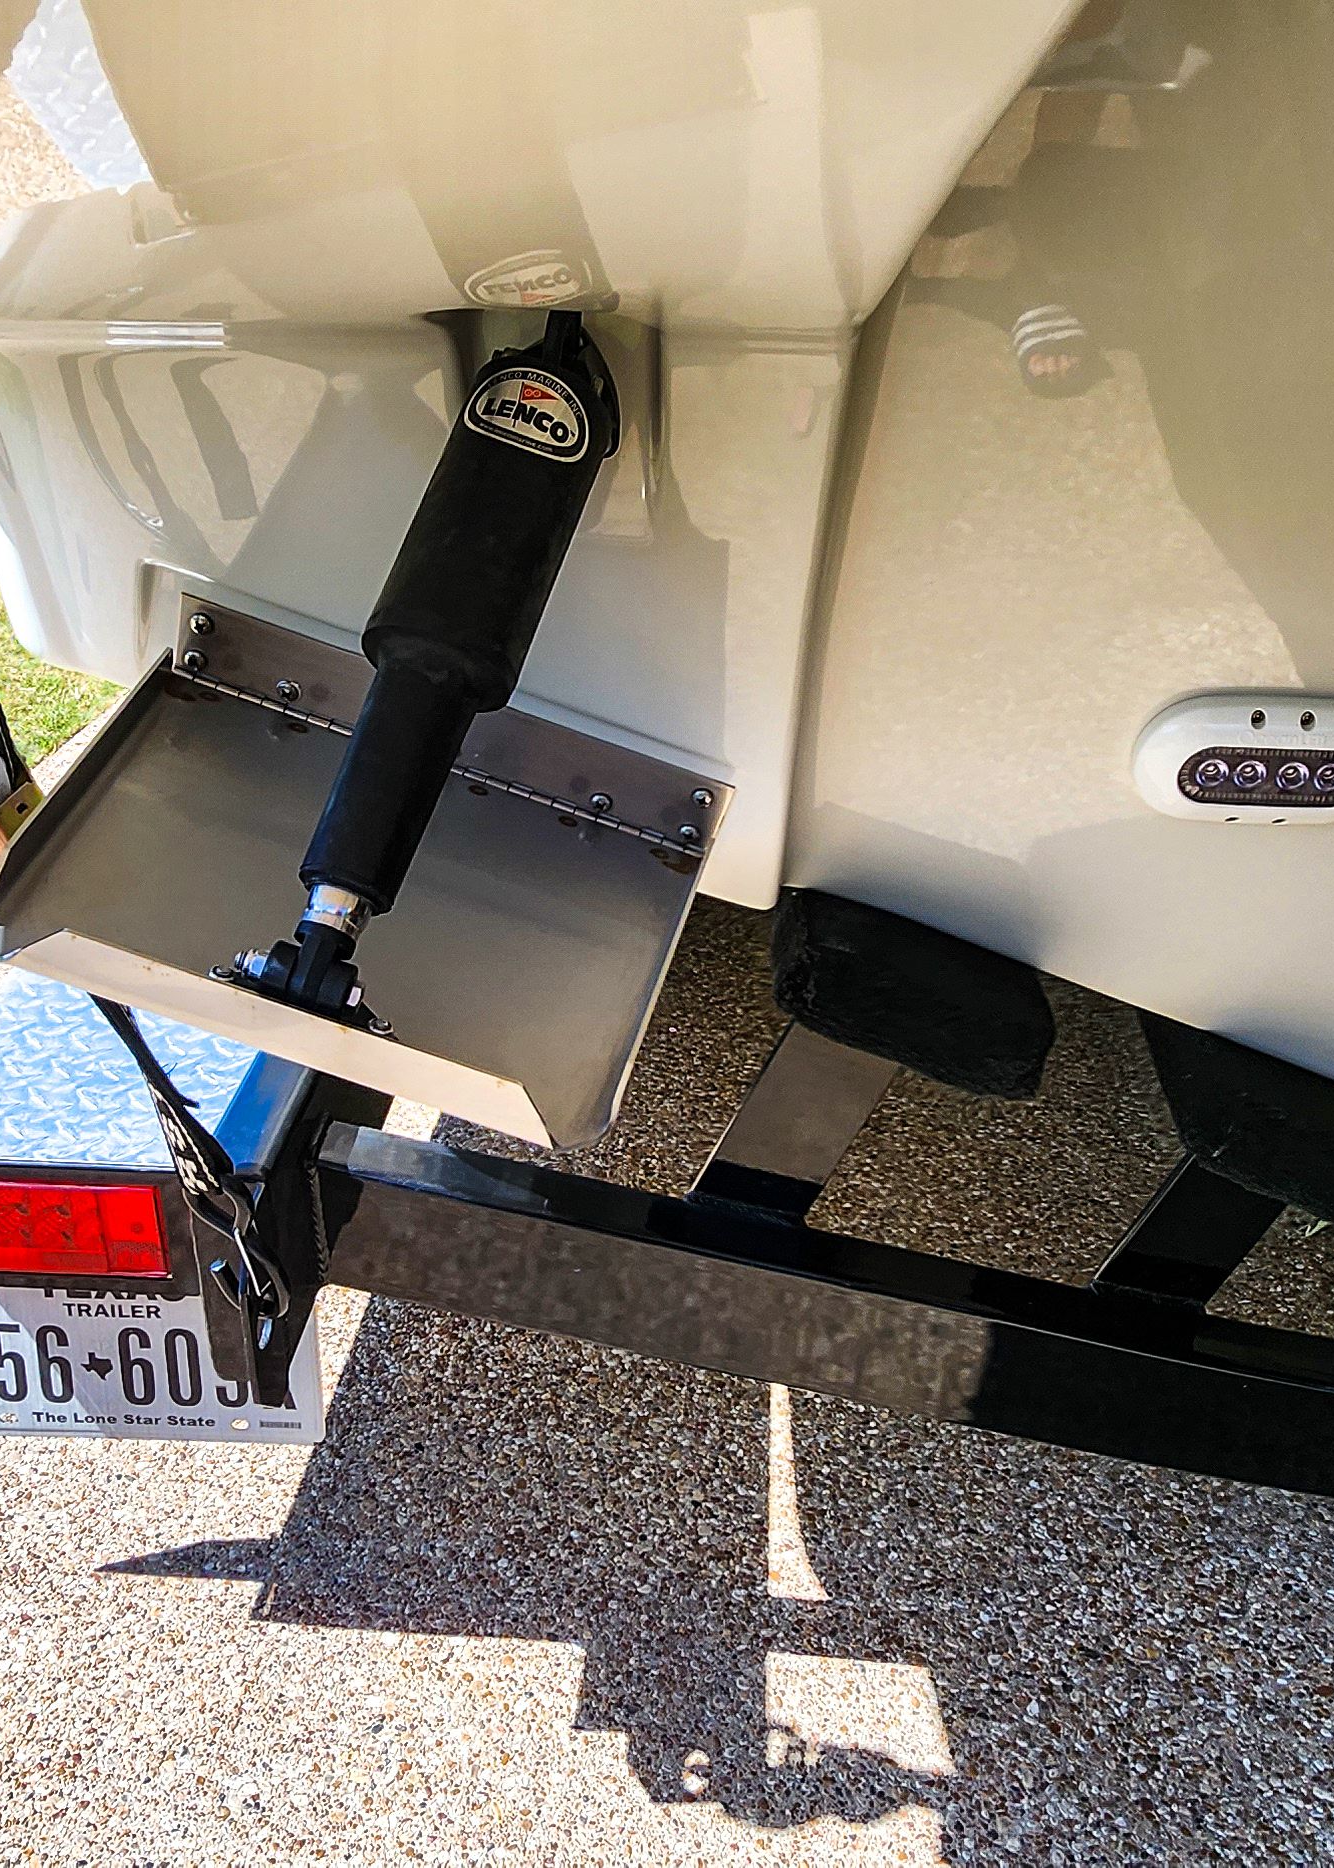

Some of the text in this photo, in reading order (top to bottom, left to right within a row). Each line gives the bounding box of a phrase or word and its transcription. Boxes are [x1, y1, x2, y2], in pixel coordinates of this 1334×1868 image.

[527, 372, 569, 398] MARINE
[480, 397, 570, 443] LENCO
[62, 1303, 161, 1318] TRAILER
[117, 1326, 298, 1410] 60
[33, 1412, 215, 1429] The Lone Star State
